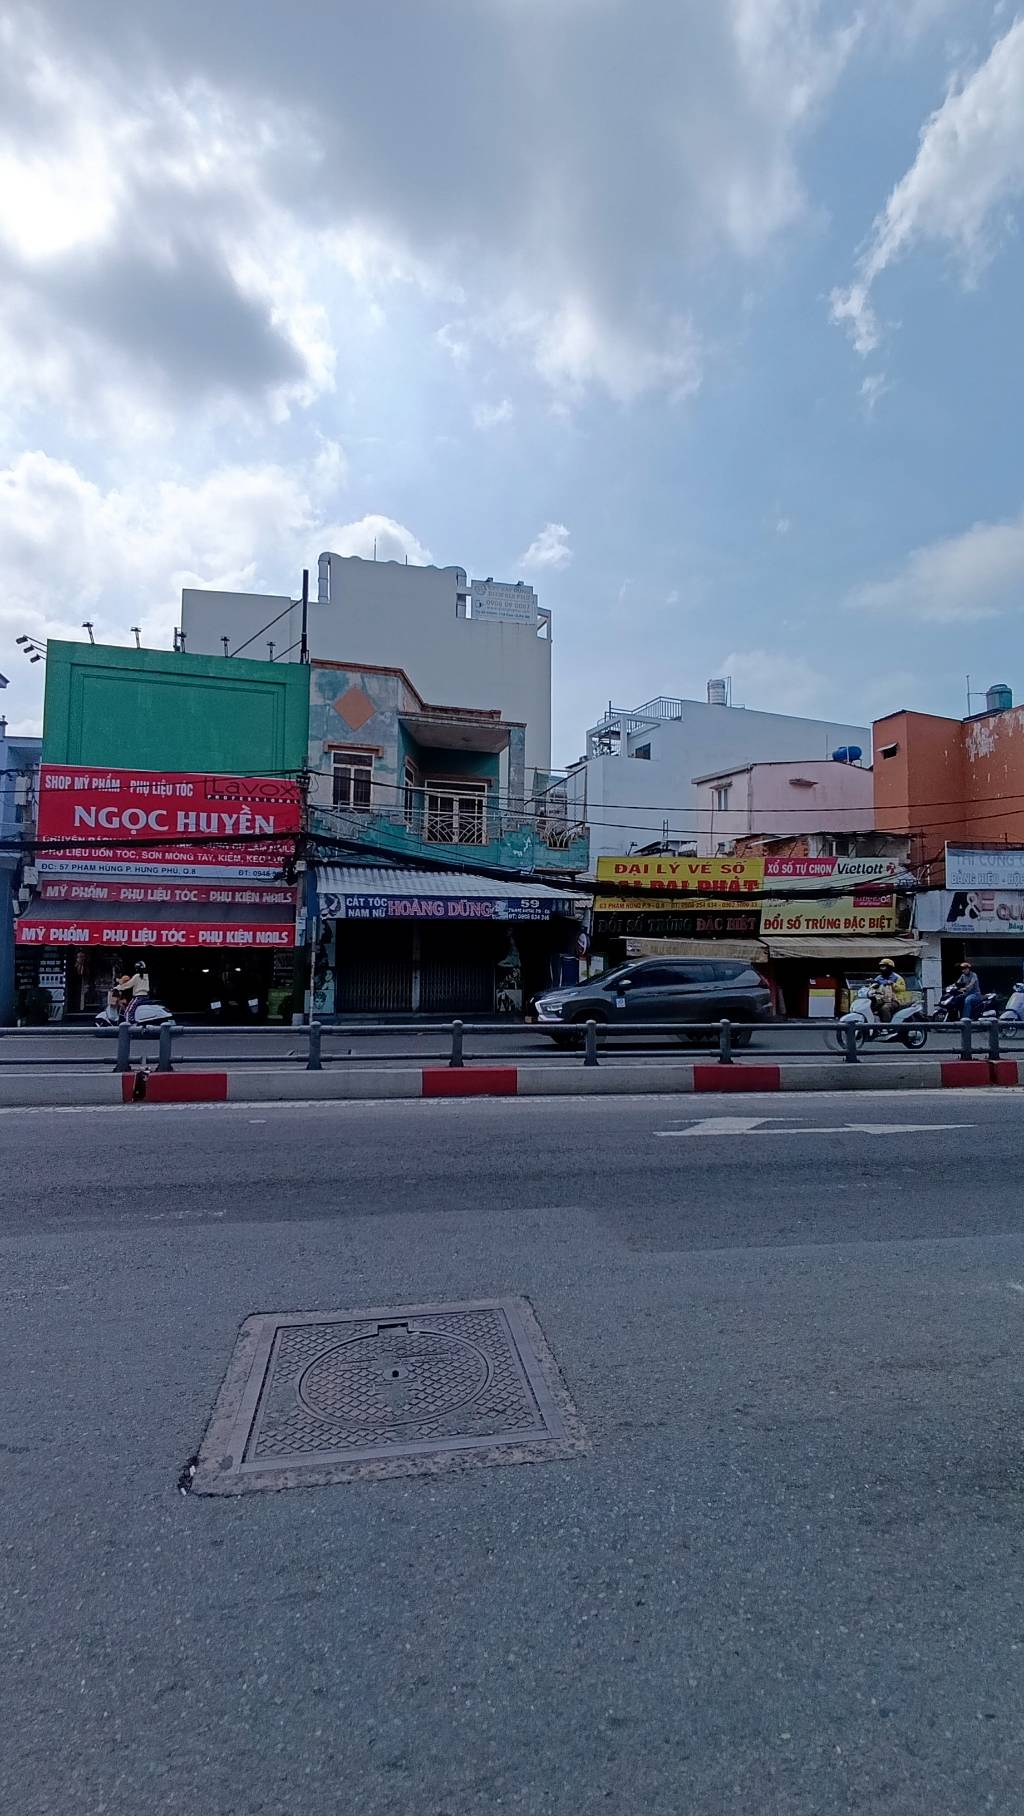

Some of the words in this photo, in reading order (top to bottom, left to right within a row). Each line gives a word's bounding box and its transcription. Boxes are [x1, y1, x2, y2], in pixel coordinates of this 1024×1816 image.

[45, 775, 71, 789] SHOP
[175, 781, 193, 797] TÓC
[212, 777, 295, 798] Lavox
[74, 805, 169, 834] NGỌC
[177, 804, 275, 834] HUYỀN
[614, 863, 649, 876] ĐẠI
[656, 861, 680, 874] LÝ
[688, 861, 712, 874] VÉ
[720, 860, 748, 874] SỐ
[767, 860, 779, 874] XỔ
[781, 860, 794, 874] SỐ
[808, 863, 833, 876] CHỌN
[837, 863, 884, 875] Vietlott
[175, 888, 198, 901] TÓC
[263, 892, 292, 903] NAILS
[520, 899, 540, 908] 59
[348, 908, 369, 918] NAM
[388, 898, 445, 916] HOÀNG
[447, 899, 492, 917] DŨNG
[763, 913, 784, 930] ĐỔI
[786, 914, 804, 930] SỐ
[805, 915, 841, 930] TRÚNG
[844, 915, 866, 932] ĐẶC
[868, 914, 893, 931] BIỆT
[161, 928, 186, 942] TÓC
[256, 930, 288, 943] NAILS
